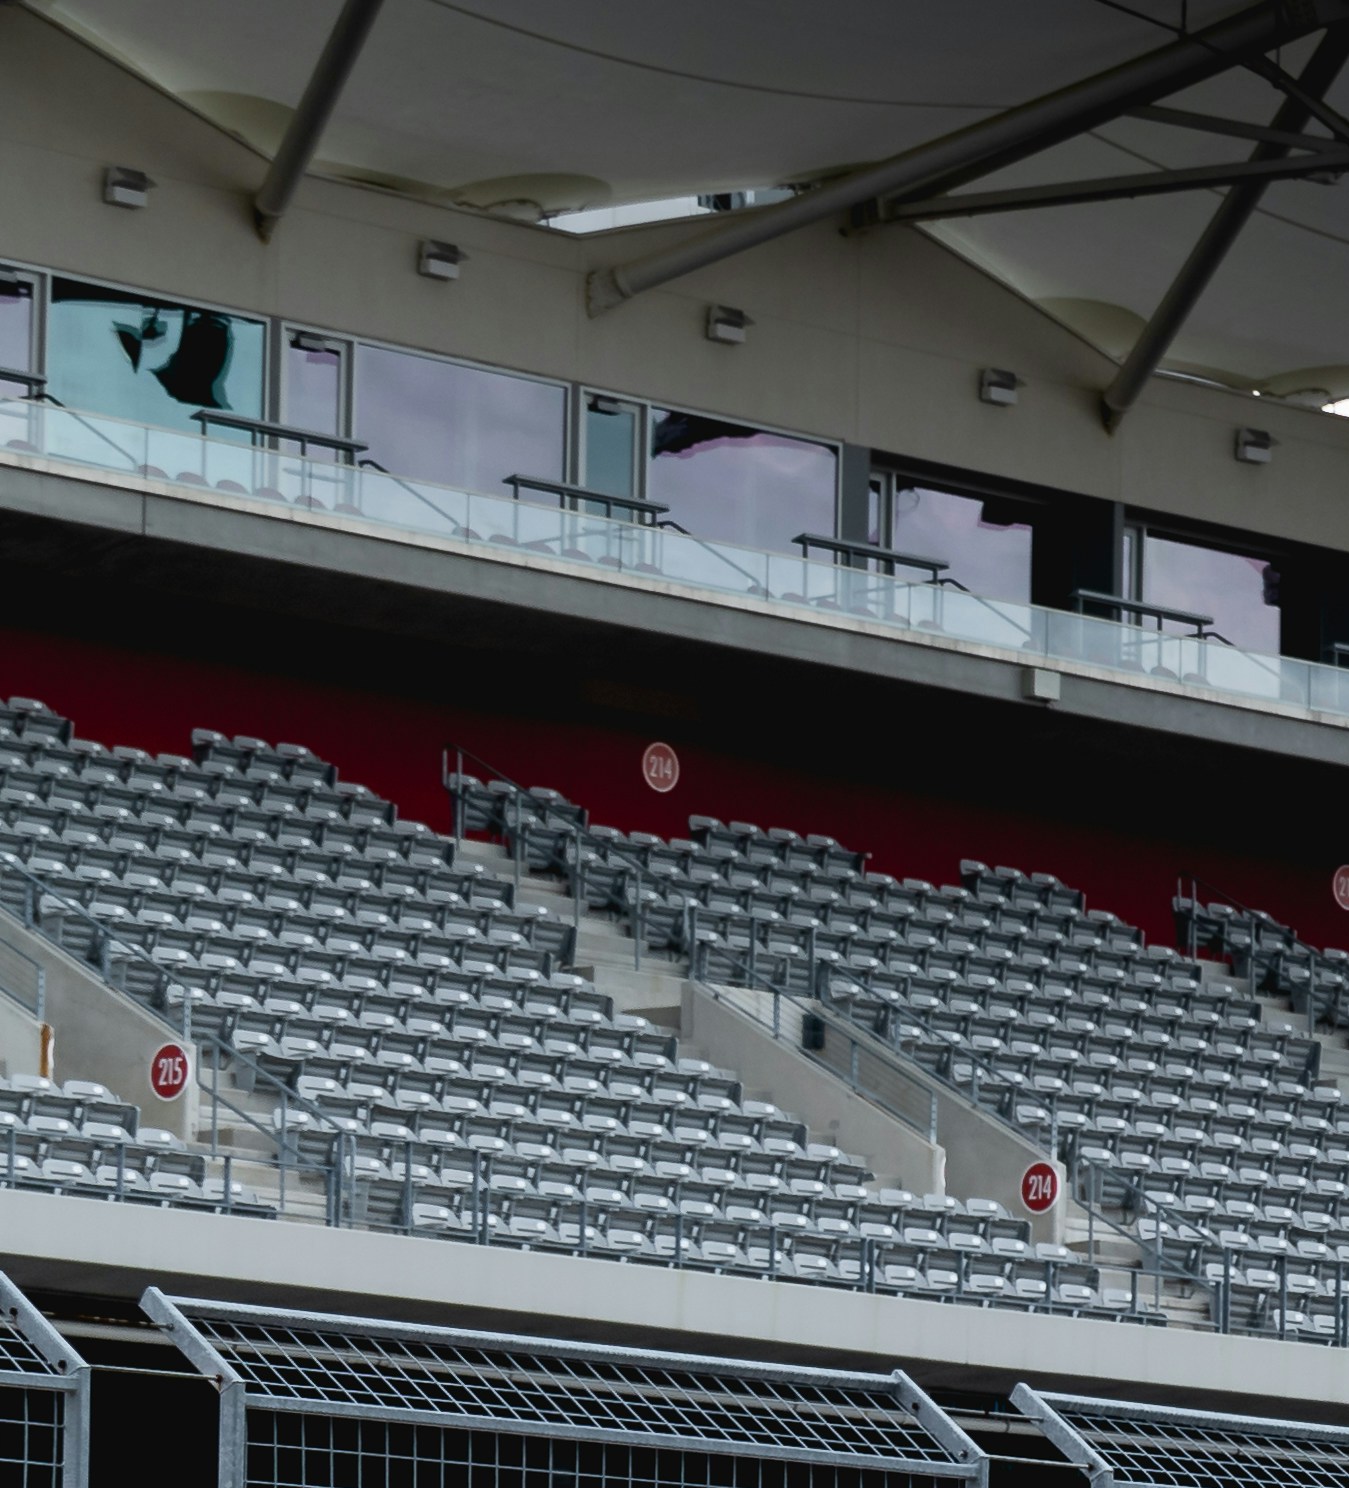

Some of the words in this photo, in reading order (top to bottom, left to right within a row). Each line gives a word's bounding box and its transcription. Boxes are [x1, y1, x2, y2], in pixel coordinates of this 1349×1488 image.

[650, 756, 672, 778] 214
[158, 1057, 184, 1086] 215
[1028, 1174, 1052, 1200] 214
